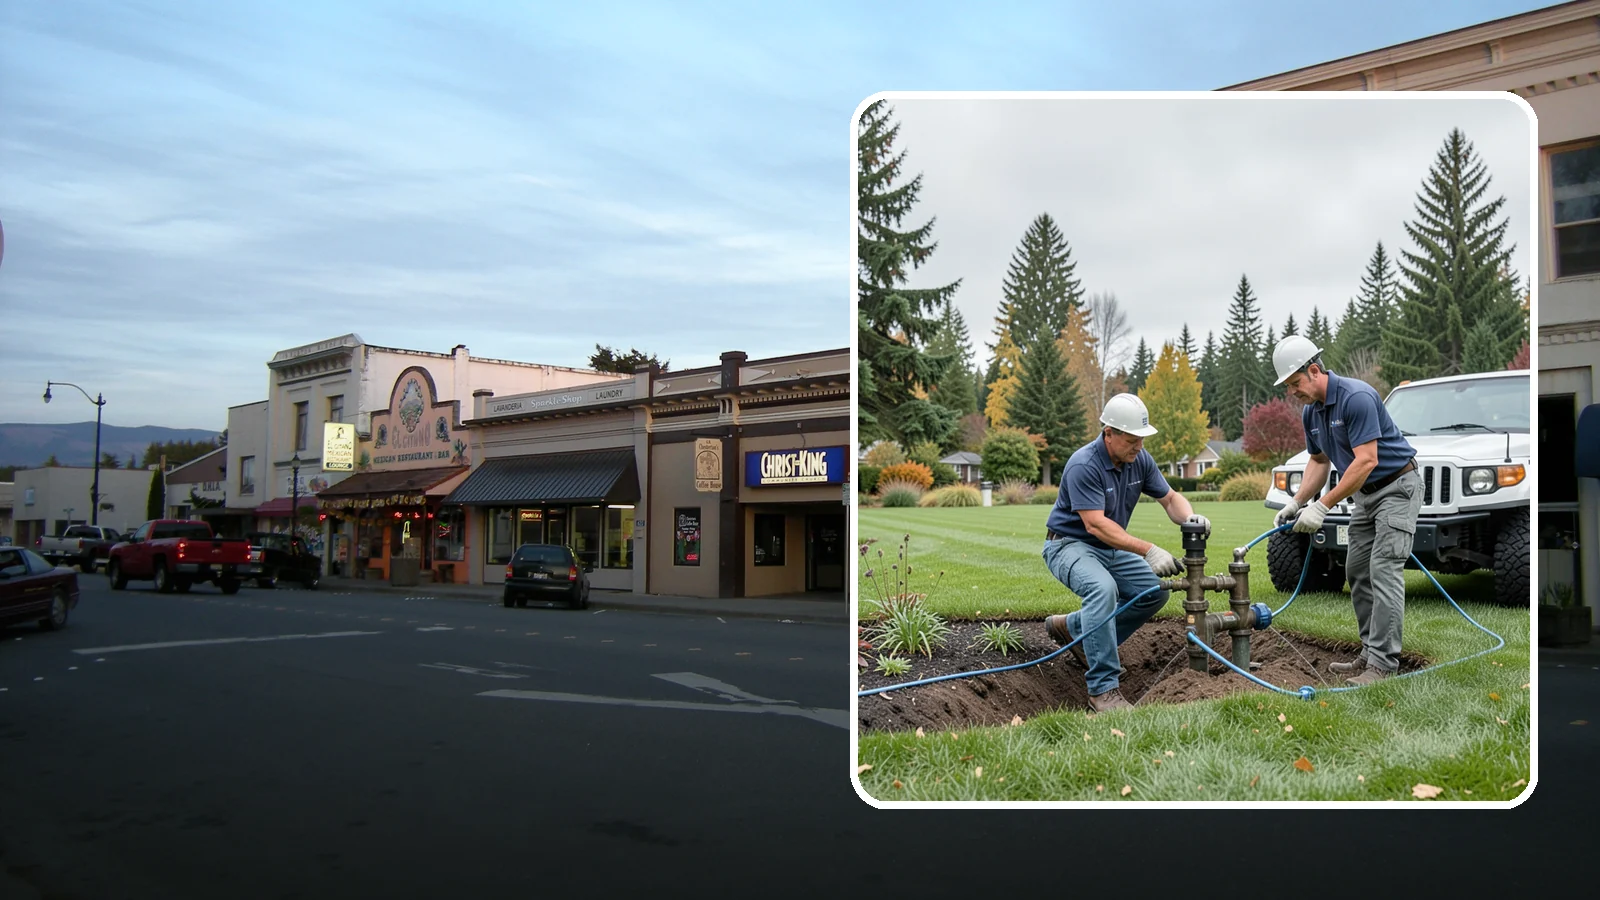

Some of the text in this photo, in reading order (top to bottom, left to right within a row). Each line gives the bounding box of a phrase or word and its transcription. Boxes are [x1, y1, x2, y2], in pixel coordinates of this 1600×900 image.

[562, 394, 583, 405] Shop
[595, 389, 624, 399] LAUNDRY
[493, 402, 522, 412] LAVANDERIA
[373, 454, 396, 464] MEXICAN
[397, 451, 433, 463] RESTAURANT
[437, 450, 450, 459] BAR
[761, 450, 827, 478] CHRIST KING
